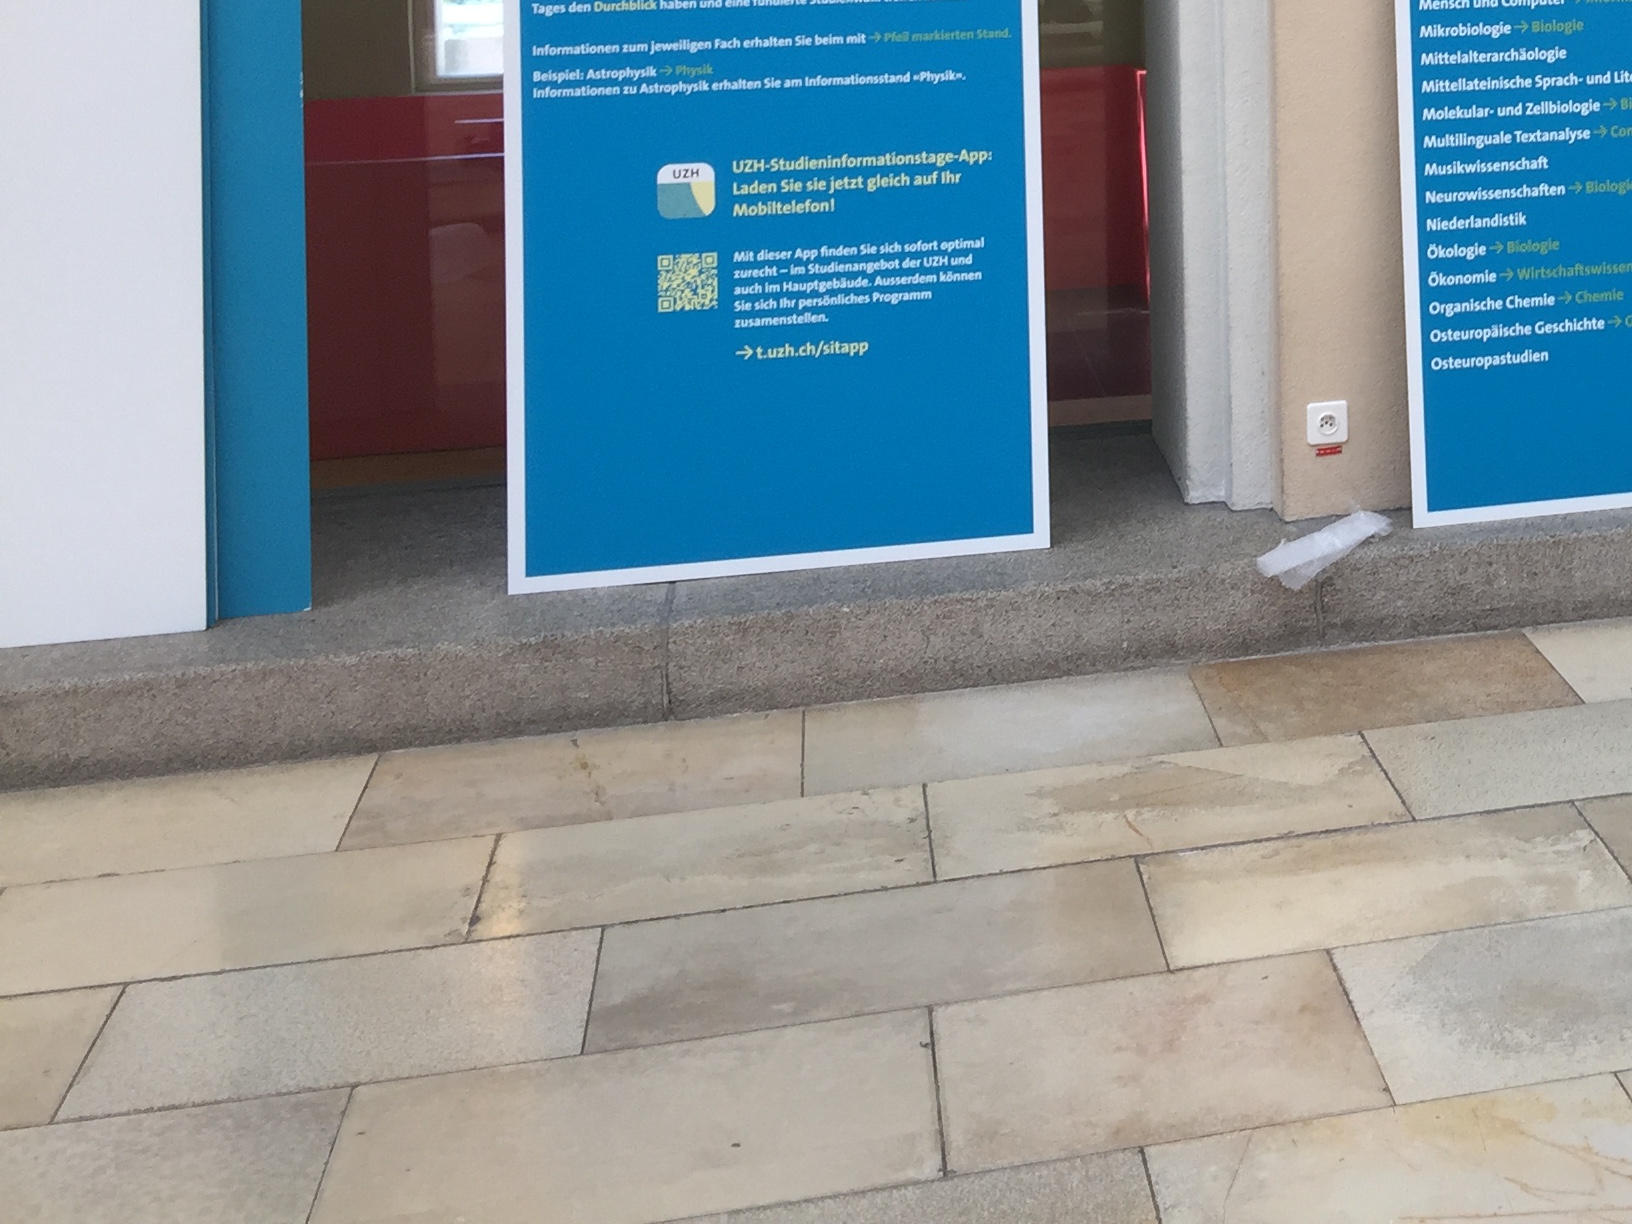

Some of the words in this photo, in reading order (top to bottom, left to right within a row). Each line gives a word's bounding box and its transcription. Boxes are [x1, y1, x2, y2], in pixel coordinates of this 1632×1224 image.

[1419, 21, 1511, 39] Mikrobiologie
[1420, 46, 1567, 65] Mittelalterarchäologie
[1421, 75, 1532, 93] Mittellateinische
[1534, 72, 1583, 90] Sprach-
[1586, 70, 1611, 85] und
[1422, 104, 1494, 120] Molekular-
[1497, 102, 1522, 117] und
[1525, 98, 1601, 116] Zellbiologie
[1423, 130, 1512, 149] Multilinguale
[1513, 127, 1591, 144] Textanalyse
[732, 149, 992, 173] UZH-Studieninformationstage-App:
[1424, 155, 1548, 176] Musikwissenschaft
[672, 168, 699, 179] UZH
[732, 179, 777, 195] Laden
[780, 178, 803, 192] Sie
[805, 177, 826, 192] sie
[829, 175, 864, 194] jetzt
[866, 172, 910, 192] gleich
[913, 170, 938, 186] auf
[940, 170, 961, 184] Ihr
[1425, 182, 1565, 203] Neurowissenschaften
[732, 197, 835, 217] Mobiltelefon!
[1426, 211, 1526, 231] Niederlandistik
[733, 250, 754, 262] Mit
[756, 249, 792, 261] dieser
[794, 247, 818, 261] App
[819, 245, 858, 257] finden
[859, 243, 877, 255] Sie
[879, 241, 902, 254] sich
[903, 239, 938, 252] sofort
[939, 236, 984, 252] optimal
[1426, 242, 1487, 260] Ökologie
[733, 265, 777, 278] zurecht
[789, 263, 805, 275] im
[807, 258, 900, 274] Studienangebot
[901, 257, 921, 268] der
[922, 255, 948, 267] UZH
[950, 253, 972, 266] und
[733, 282, 762, 295] auch
[764, 282, 780, 293] im
[782, 276, 872, 293] Hauptgebäude.
[873, 272, 937, 286] Ausserdem
[939, 271, 982, 282] können
[1427, 269, 1497, 287] Ökonomie
[733, 299, 752, 312] Sie
[753, 298, 777, 310] sich
[779, 297, 796, 308] Ihr
[798, 292, 870, 310] persönliches
[872, 290, 932, 304] Programm
[1428, 296, 1503, 317] Organische
[1505, 292, 1555, 309] Chemie
[1429, 322, 1532, 343] Osteuropäische
[1534, 317, 1605, 334] Geschichte
[755, 340, 869, 359] t.uzh.ch/sitapp
[1430, 349, 1549, 370] Osteuropastudien
